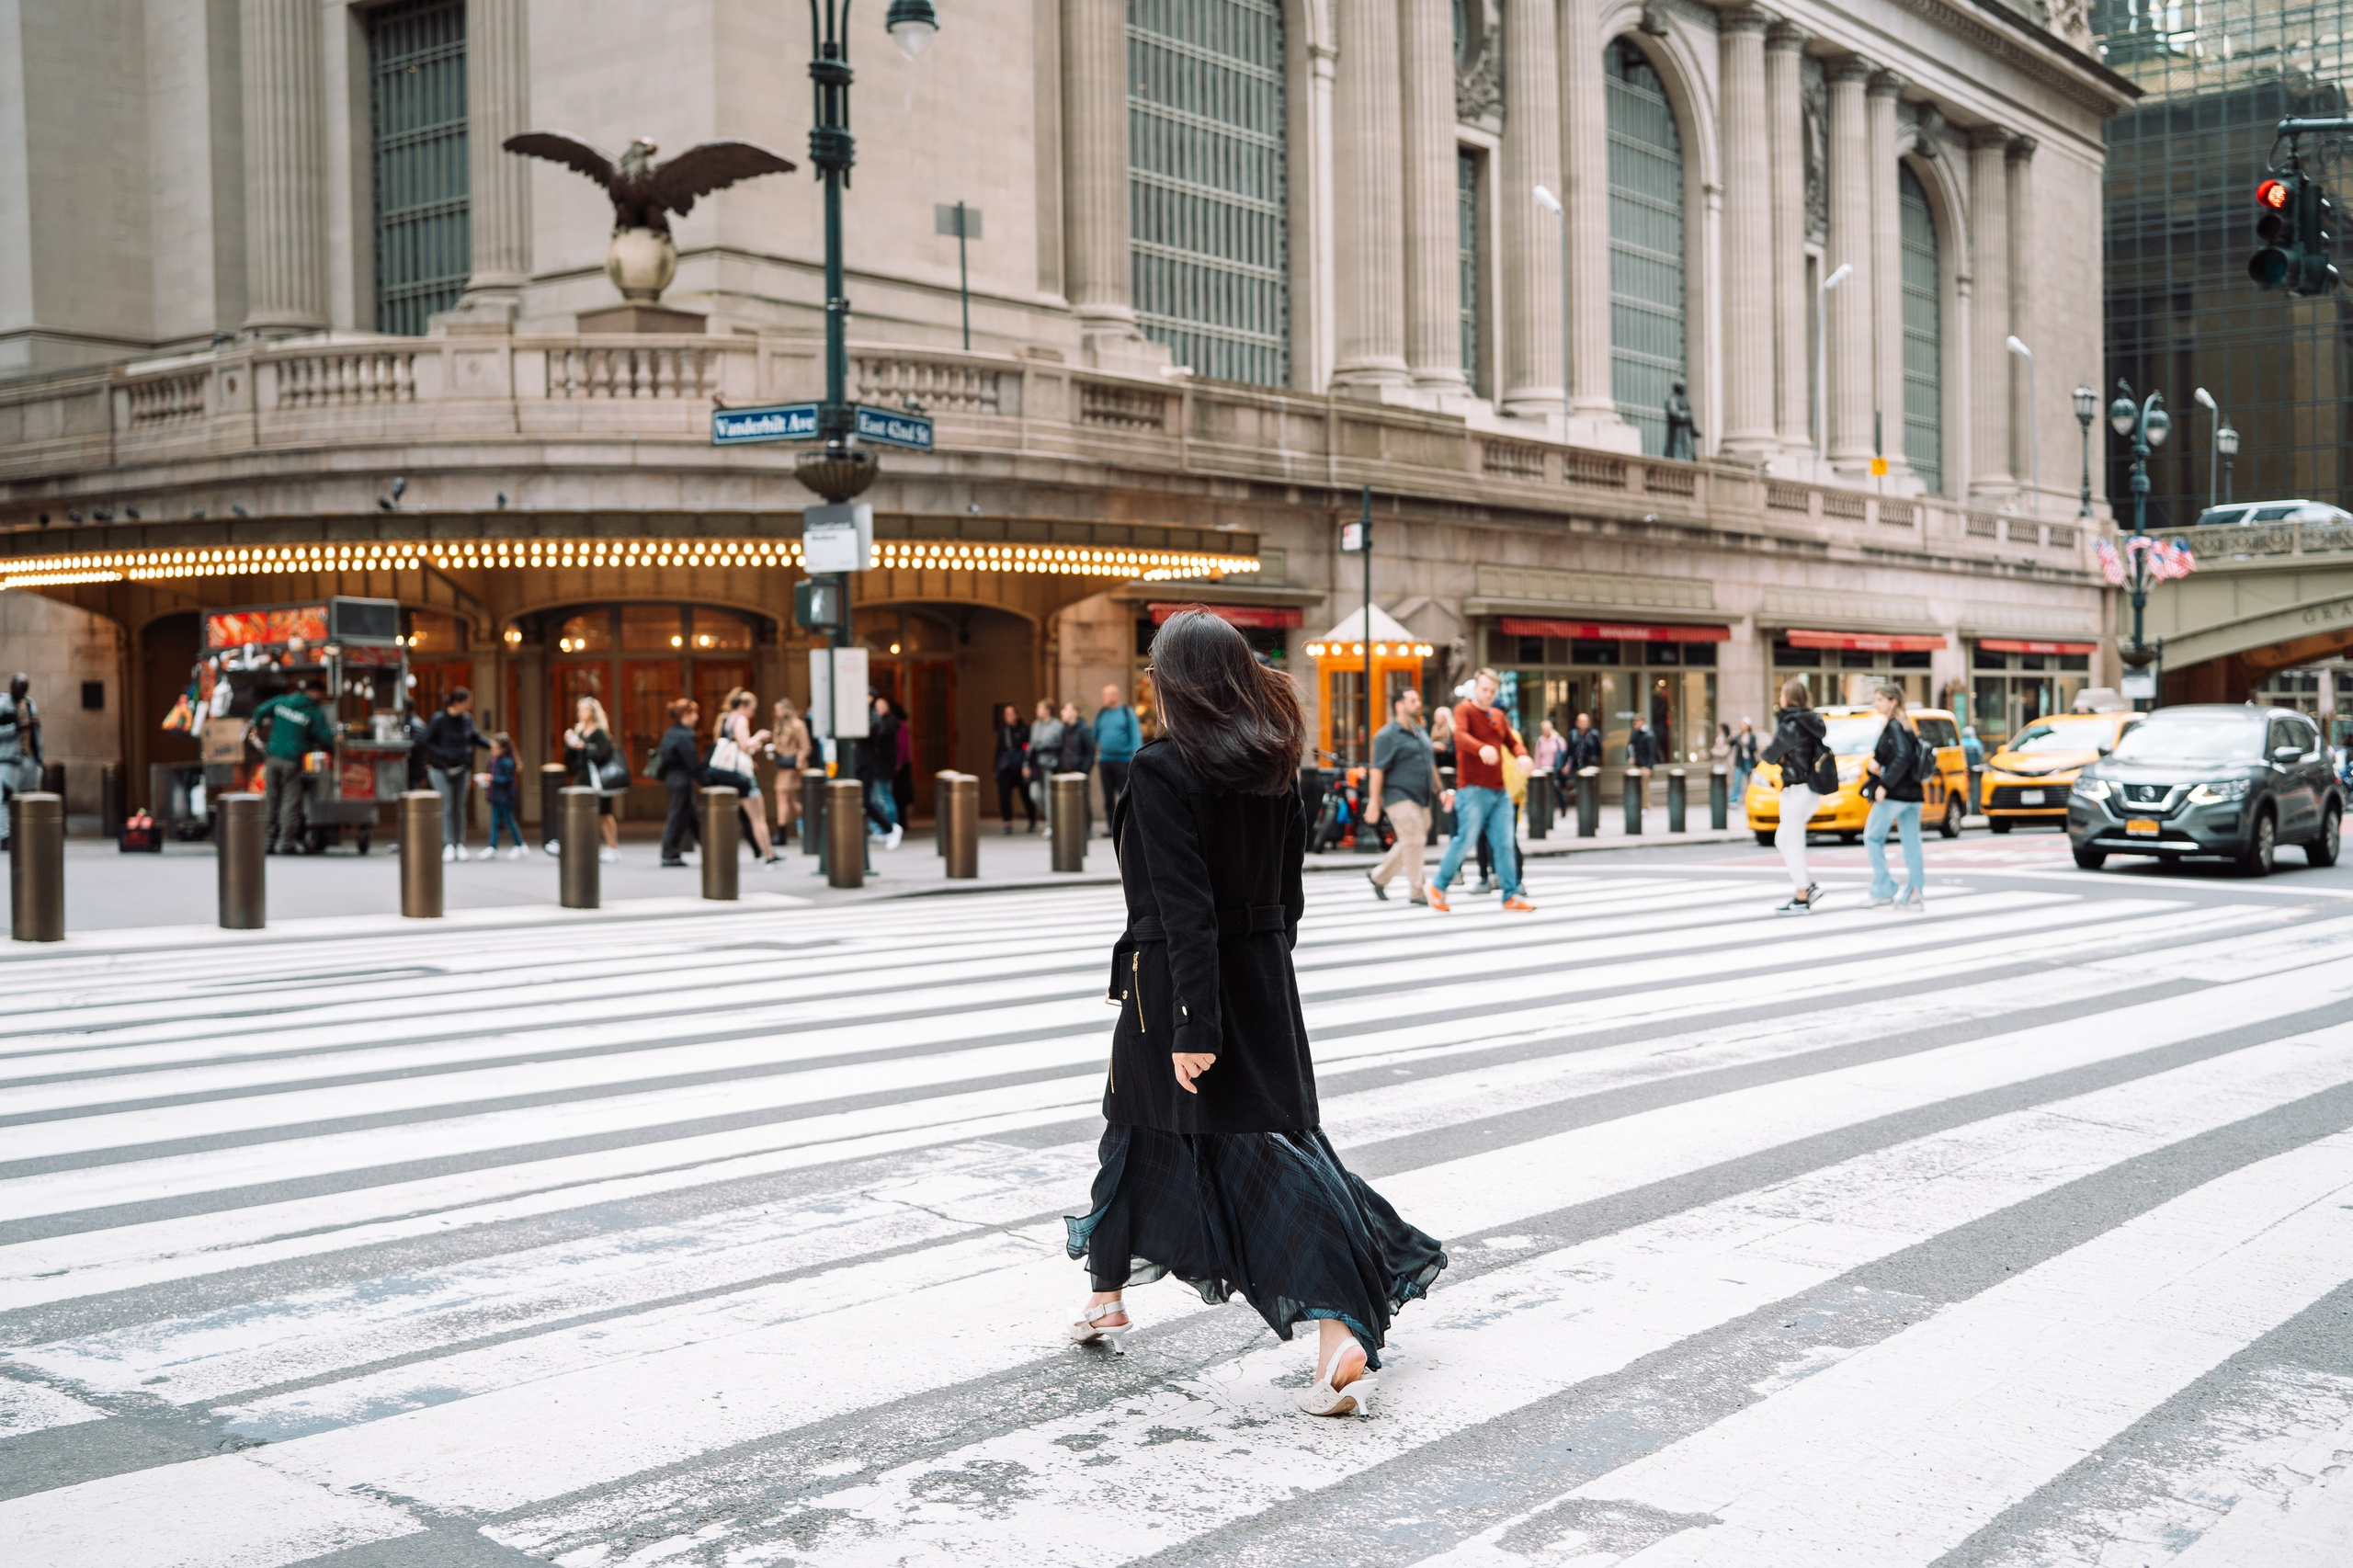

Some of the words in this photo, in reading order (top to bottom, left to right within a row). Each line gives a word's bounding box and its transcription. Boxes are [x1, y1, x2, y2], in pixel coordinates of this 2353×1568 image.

[716, 415, 786, 437] Vanderbilt
[788, 413, 815, 432] Ave
[859, 414, 885, 436] East
[887, 420, 915, 441] 42nd
[915, 425, 929, 444] St
